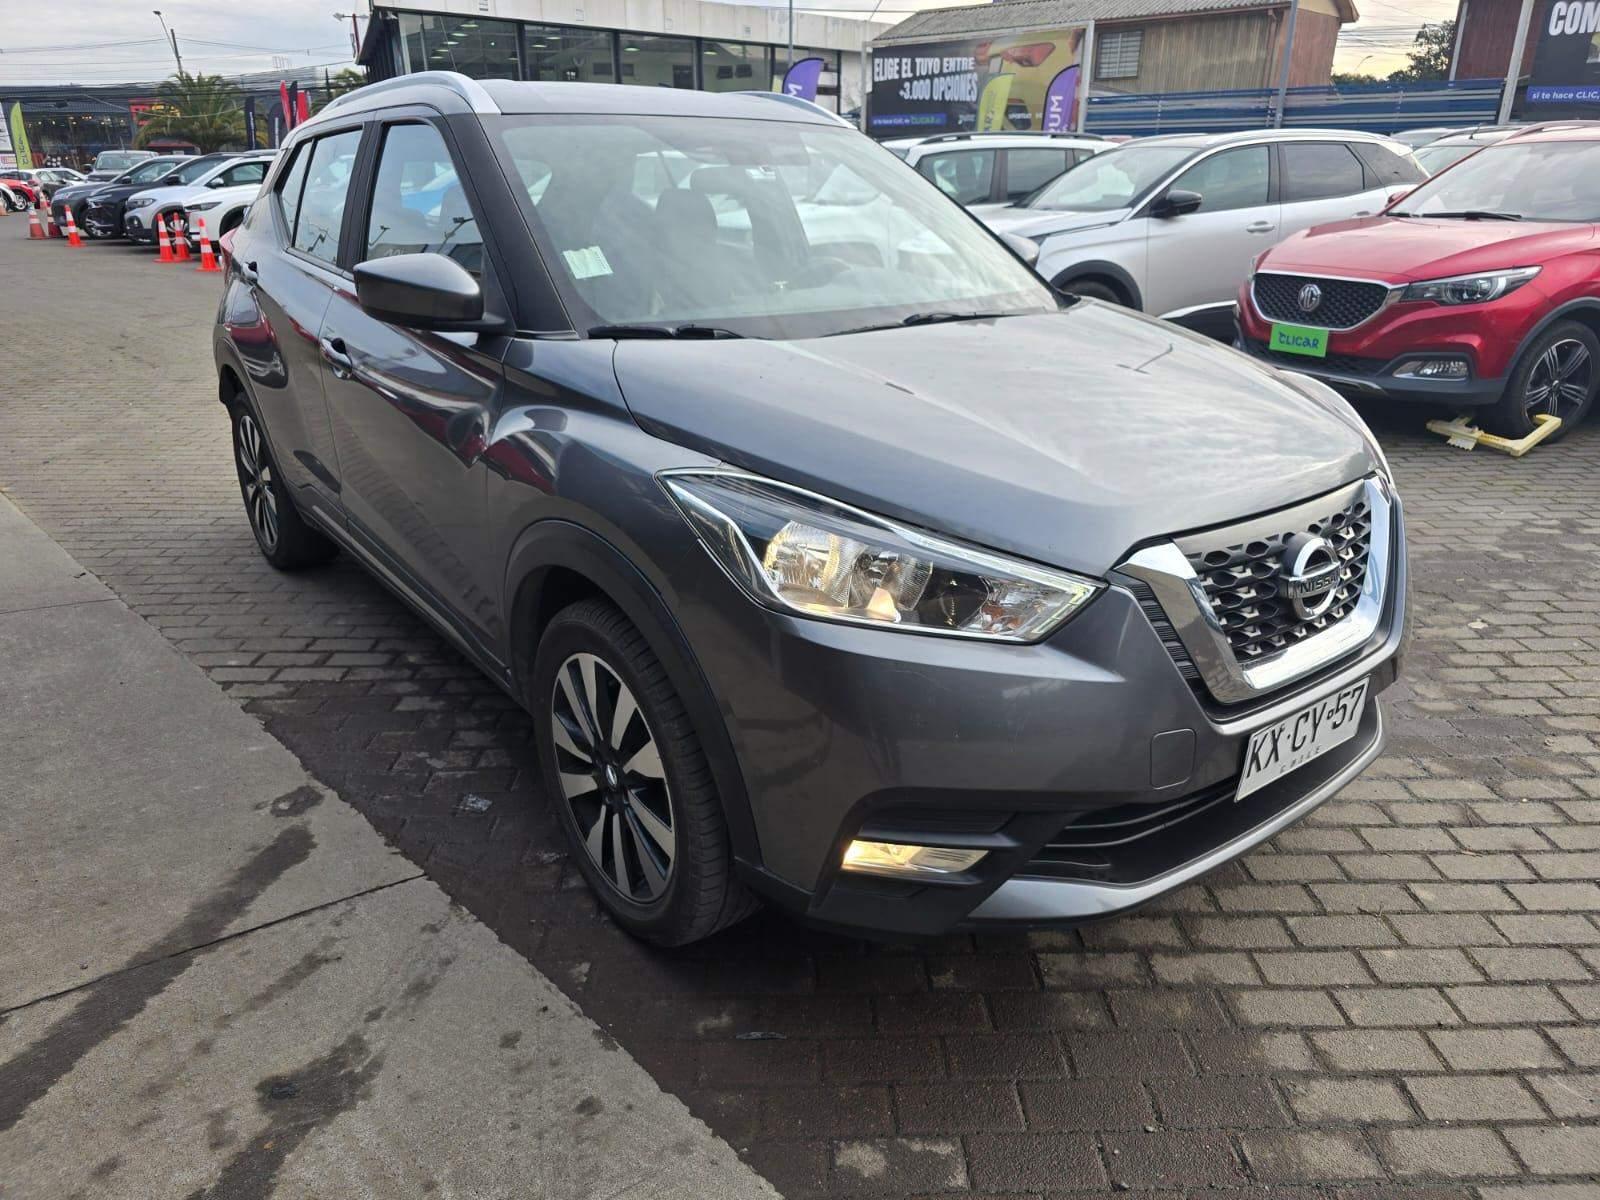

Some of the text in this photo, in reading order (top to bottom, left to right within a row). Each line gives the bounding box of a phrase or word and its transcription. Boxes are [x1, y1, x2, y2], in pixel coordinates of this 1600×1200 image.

[1549, 1, 1600, 36] COM
[874, 57, 975, 82] ELIGE EL TUYO ENTRE
[932, 72, 978, 102] OPCIONES
[1532, 92, 1539, 100] si
[1541, 92, 1550, 100] te
[1552, 91, 1573, 100] hace
